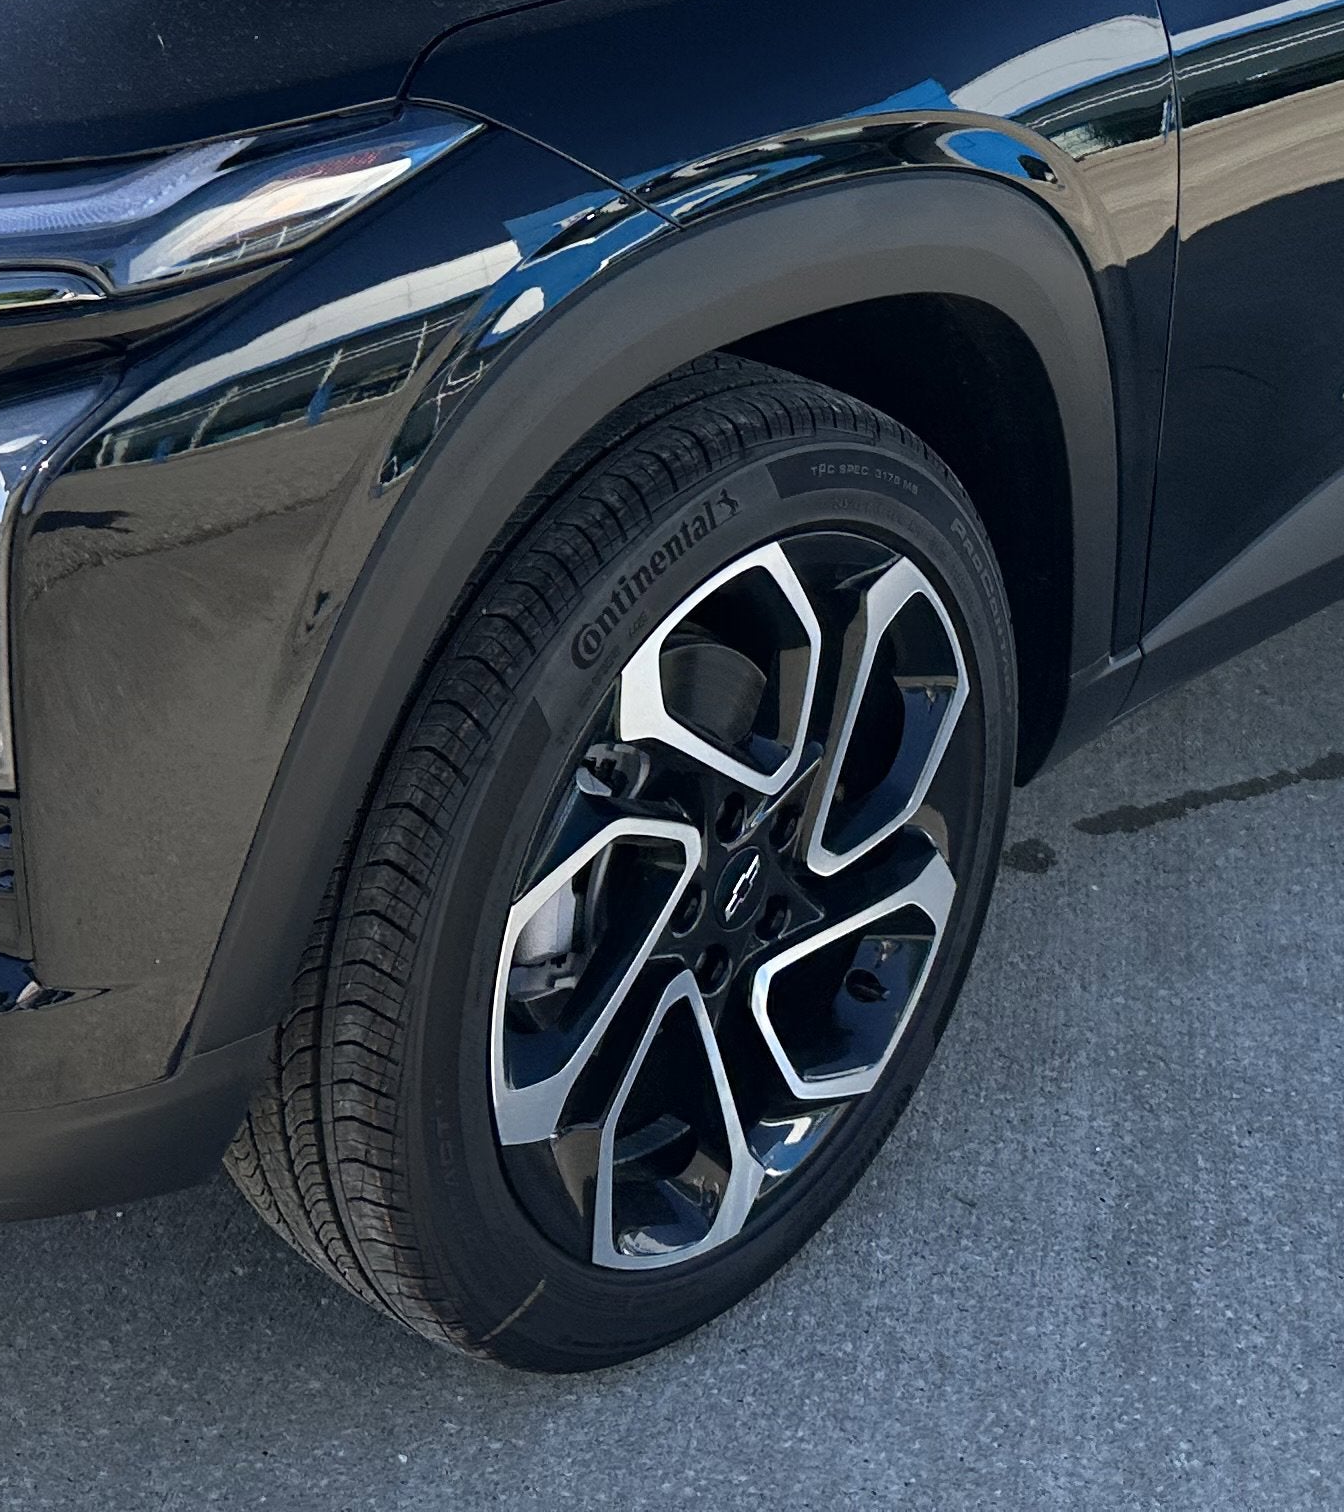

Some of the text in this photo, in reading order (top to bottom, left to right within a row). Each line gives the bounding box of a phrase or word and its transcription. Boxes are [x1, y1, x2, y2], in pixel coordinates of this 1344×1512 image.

[810, 463, 835, 478] TPC
[839, 464, 869, 476] SPEC
[571, 500, 718, 670] Continental
